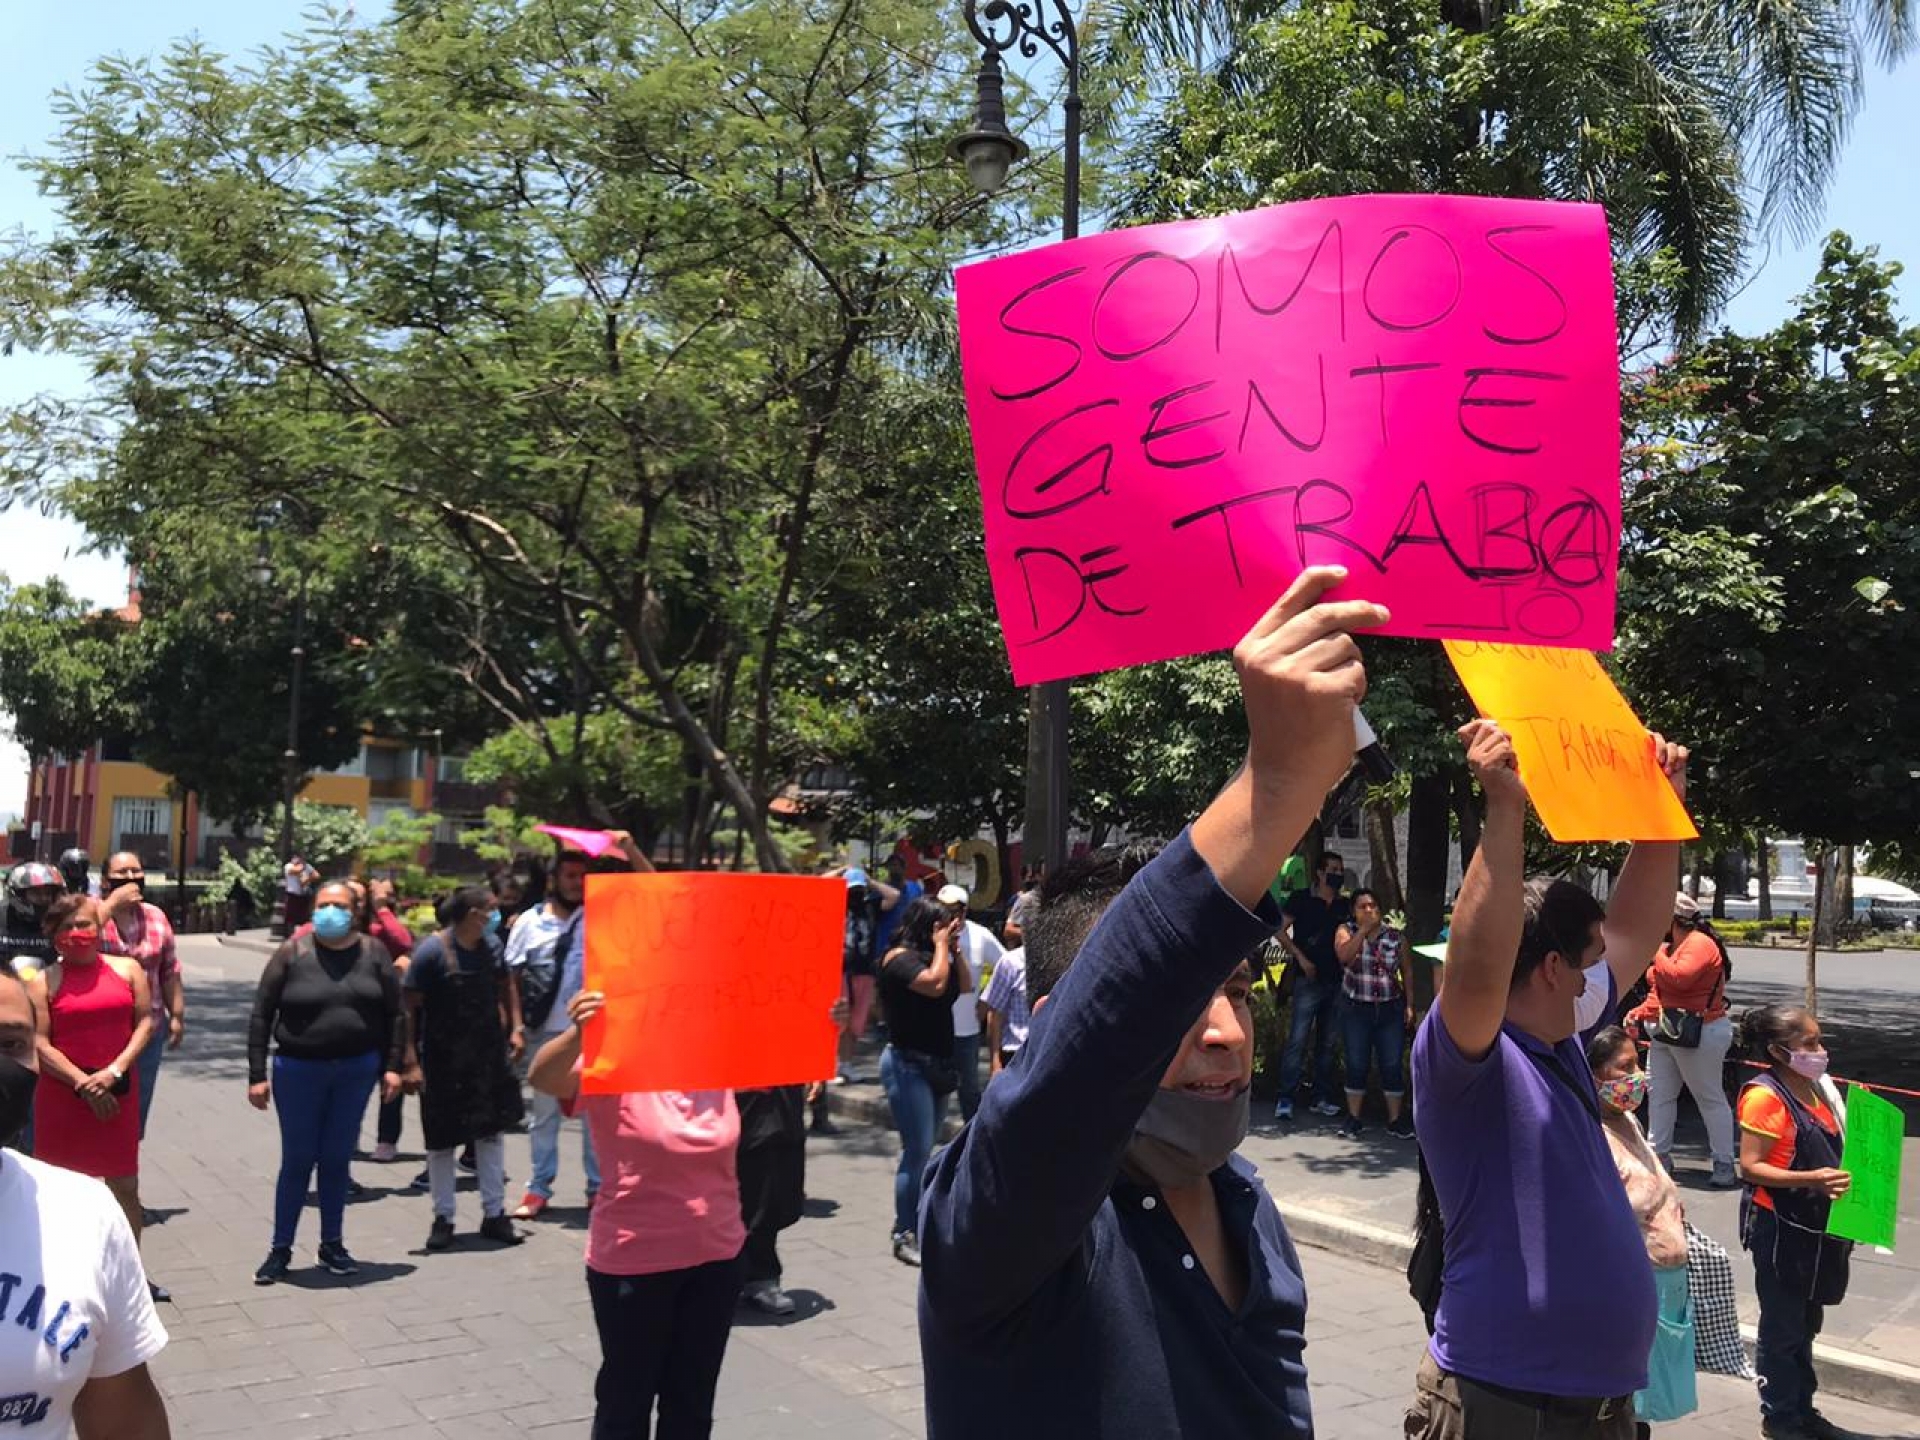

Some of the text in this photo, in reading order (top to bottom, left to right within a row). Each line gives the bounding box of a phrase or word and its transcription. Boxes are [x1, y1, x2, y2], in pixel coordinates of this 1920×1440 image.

[989, 219, 1568, 401] SOMOS
[1002, 354, 1568, 519] GENTE
[1014, 545, 1147, 647] DE
